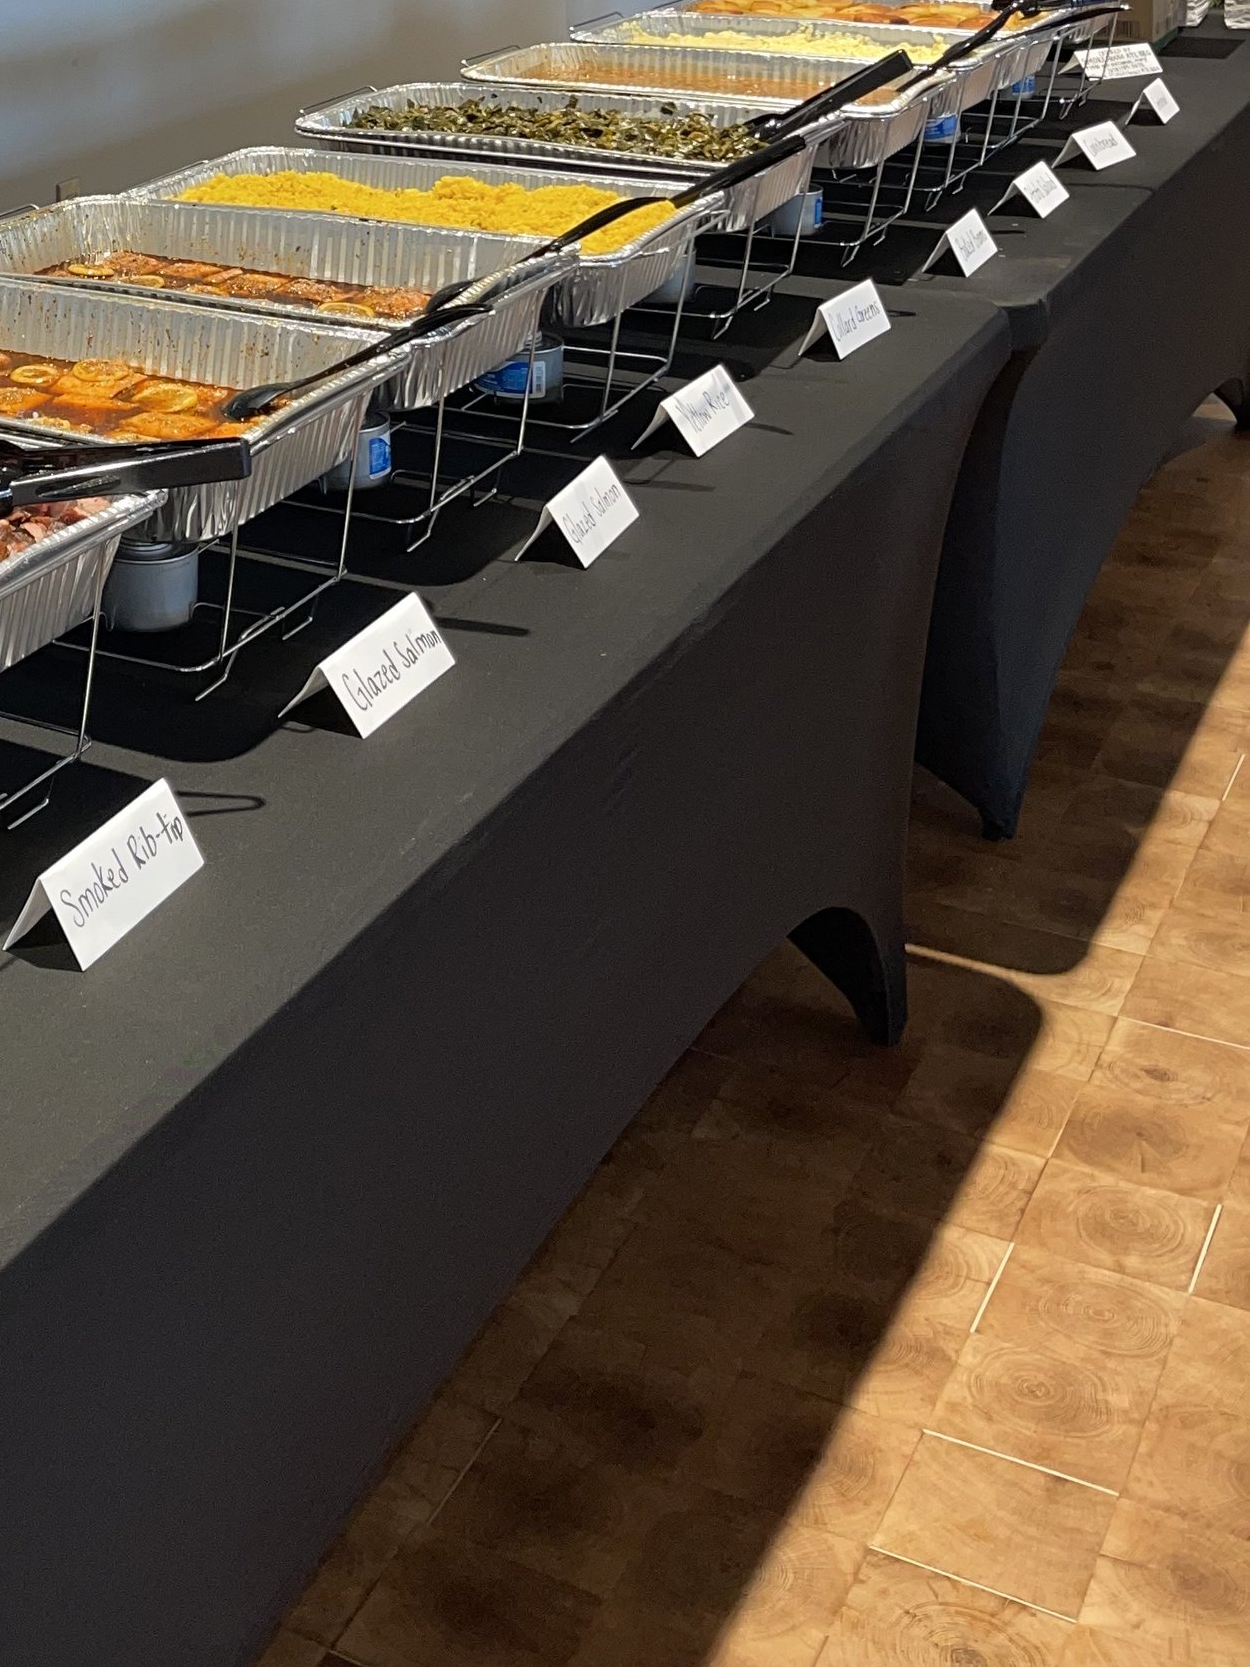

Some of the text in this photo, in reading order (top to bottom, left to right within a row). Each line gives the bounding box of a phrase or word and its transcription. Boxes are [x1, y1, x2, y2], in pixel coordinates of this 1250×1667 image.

[702, 391, 729, 415] Rice
[562, 501, 596, 545] Glazed
[341, 630, 442, 711] Glazed Salmon
[60, 812, 184, 928] Smoked Rib-tip
